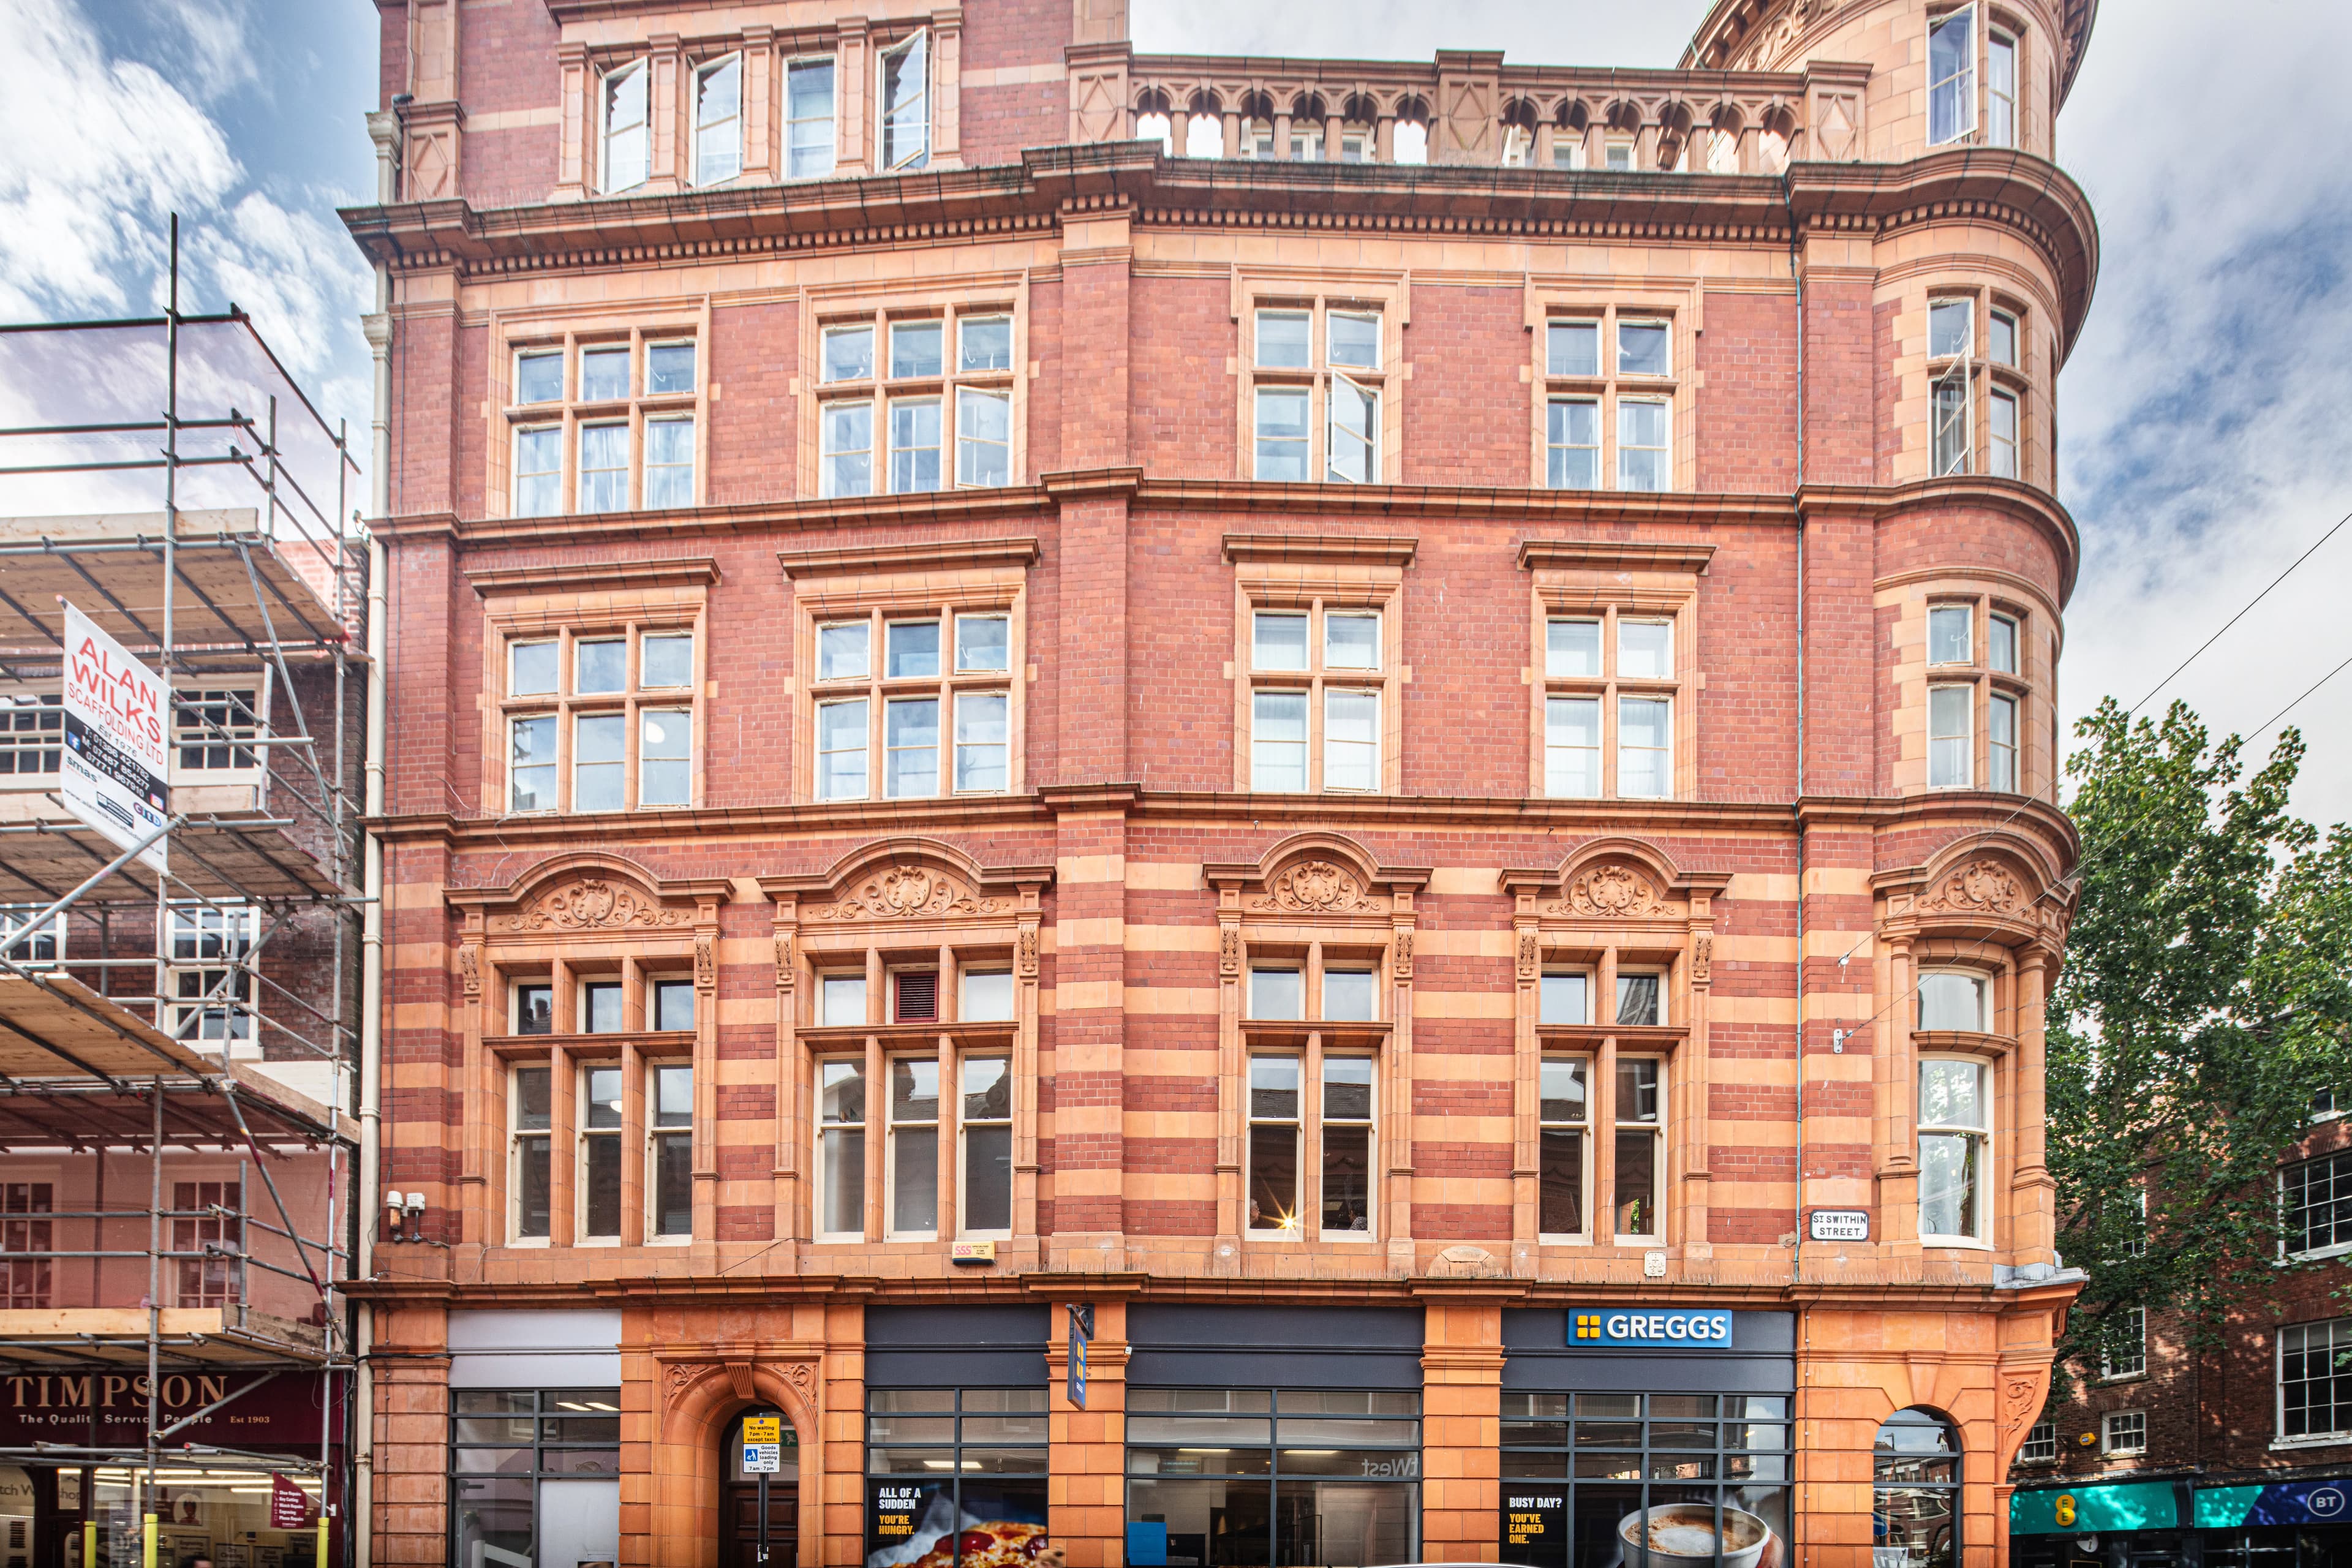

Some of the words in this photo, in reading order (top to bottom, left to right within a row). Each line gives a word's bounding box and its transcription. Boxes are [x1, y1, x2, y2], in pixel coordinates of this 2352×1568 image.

[79, 637, 157, 714] ALAN
[72, 654, 161, 744] WILKS
[69, 682, 144, 750] SCAFFOLDING
[146, 741, 164, 765] LTD
[83, 725, 92, 739] T:
[81, 735, 91, 750] M:
[98, 724, 112, 740] Est
[115, 739, 138, 758] 1976
[67, 756, 98, 783] smas
[134, 802, 162, 827] citb
[1826, 1215, 1867, 1224] SWITHIN
[1819, 1227, 1863, 1236] STREET.
[956, 1245, 971, 1255] SSS
[1607, 1315, 1726, 1340] GREGGS
[6, 1375, 228, 1408] TIMPSON
[19, 1414, 43, 1423] The
[49, 1414, 91, 1425] Qualit
[104, 1414, 149, 1423] Servic
[164, 1414, 212, 1425] Peple
[879, 1488, 897, 1498] ALL
[900, 1488, 912, 1498] OF
[914, 1488, 921, 1498] A
[879, 1499, 916, 1509] SUDDEN
[1509, 1497, 1534, 1508] BUSY
[1537, 1497, 1562, 1508] DAY?
[2316, 1496, 2337, 1508] BT
[2061, 1499, 2068, 1521] EE
[879, 1515, 910, 1525] YOU'RE
[1509, 1513, 1541, 1523] YOU'VE
[878, 1525, 915, 1535] HUNGRY.
[1509, 1524, 1544, 1534] EARNED
[1509, 1534, 1529, 1544] ONE.
